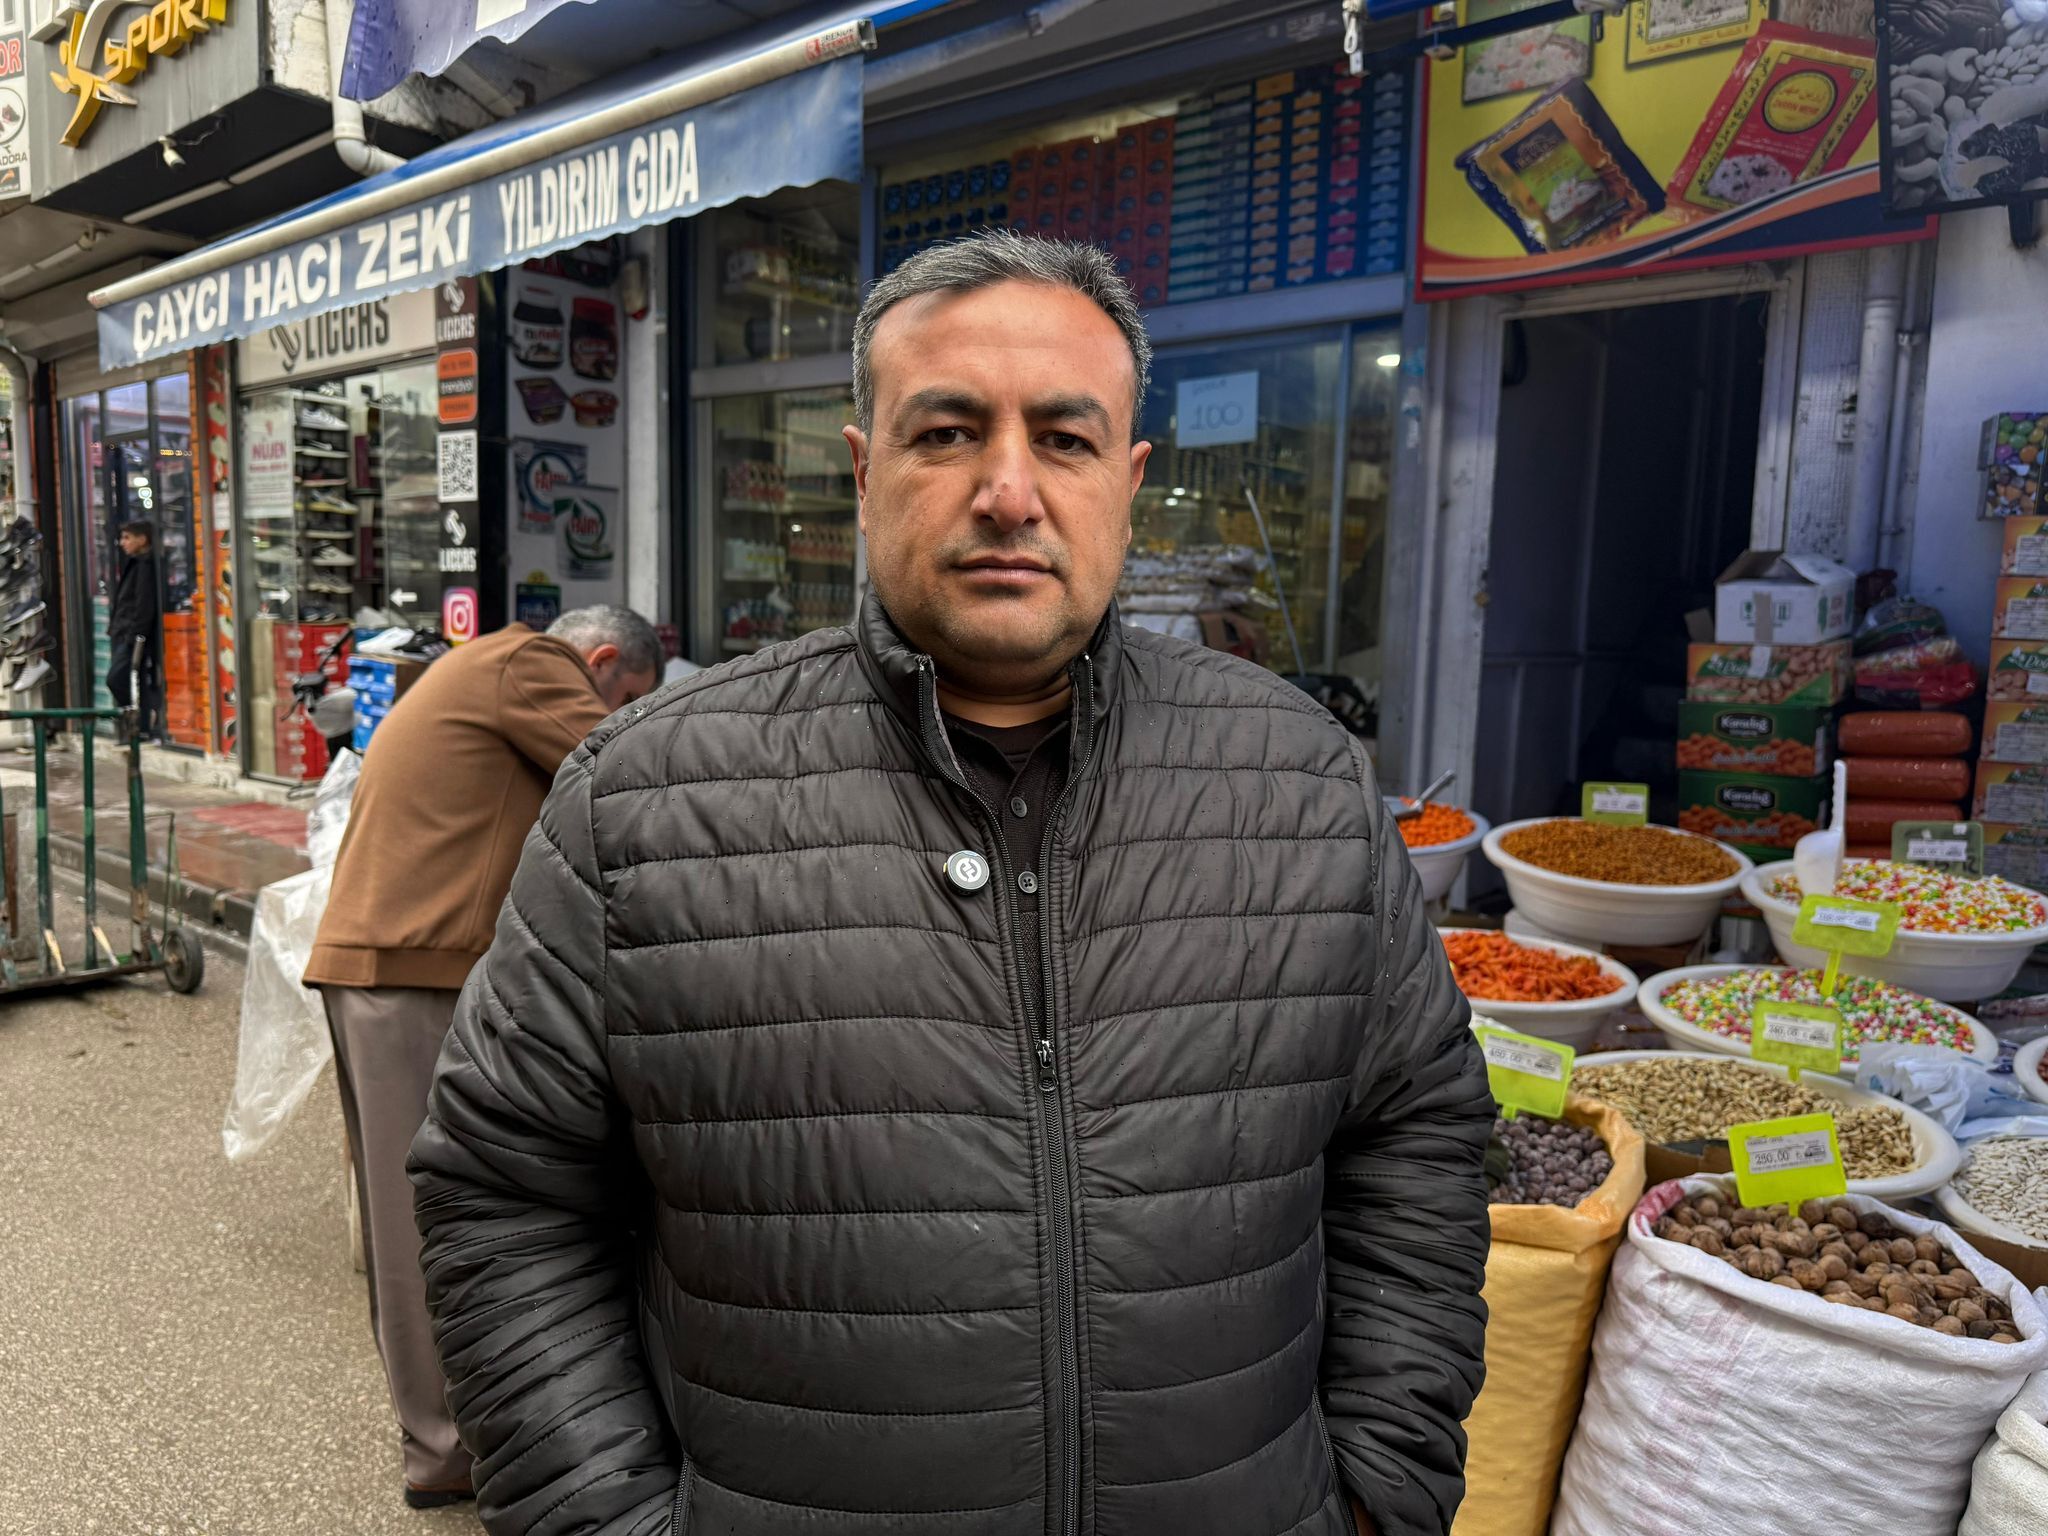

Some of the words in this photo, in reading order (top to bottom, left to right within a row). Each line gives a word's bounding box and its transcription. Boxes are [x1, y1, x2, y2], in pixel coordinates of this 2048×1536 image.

[243, 236, 342, 323] HACI
[499, 144, 619, 255] YILDIRIM
[626, 120, 699, 220] GIDA
[1188, 401, 1244, 430] 100
